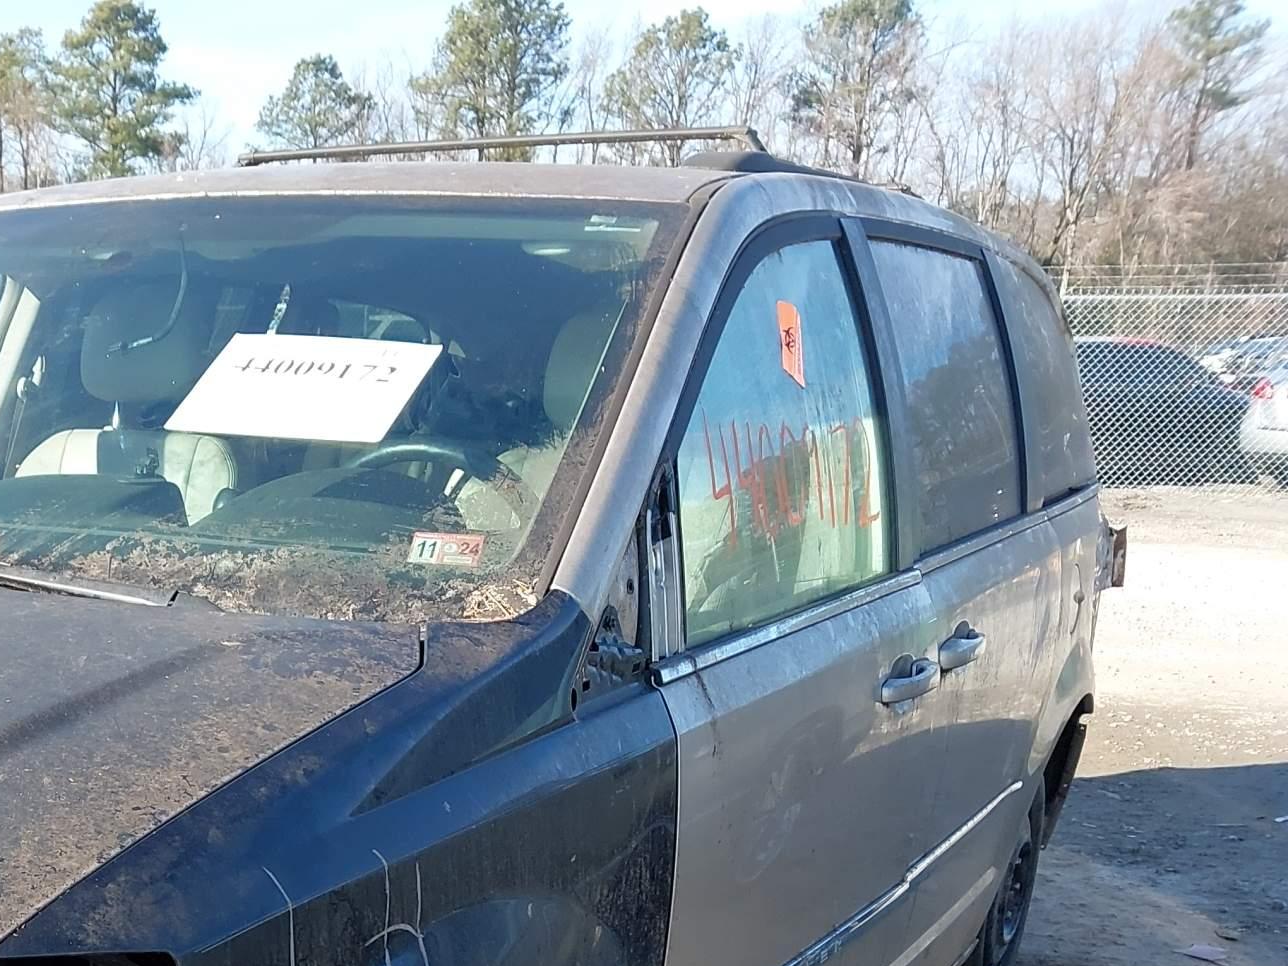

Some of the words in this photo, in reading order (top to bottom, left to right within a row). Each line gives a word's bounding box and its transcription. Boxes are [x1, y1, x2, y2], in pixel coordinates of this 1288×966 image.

[232, 355, 399, 383] 44009172
[417, 540, 438, 559] 11
[459, 541, 480, 556] 24
